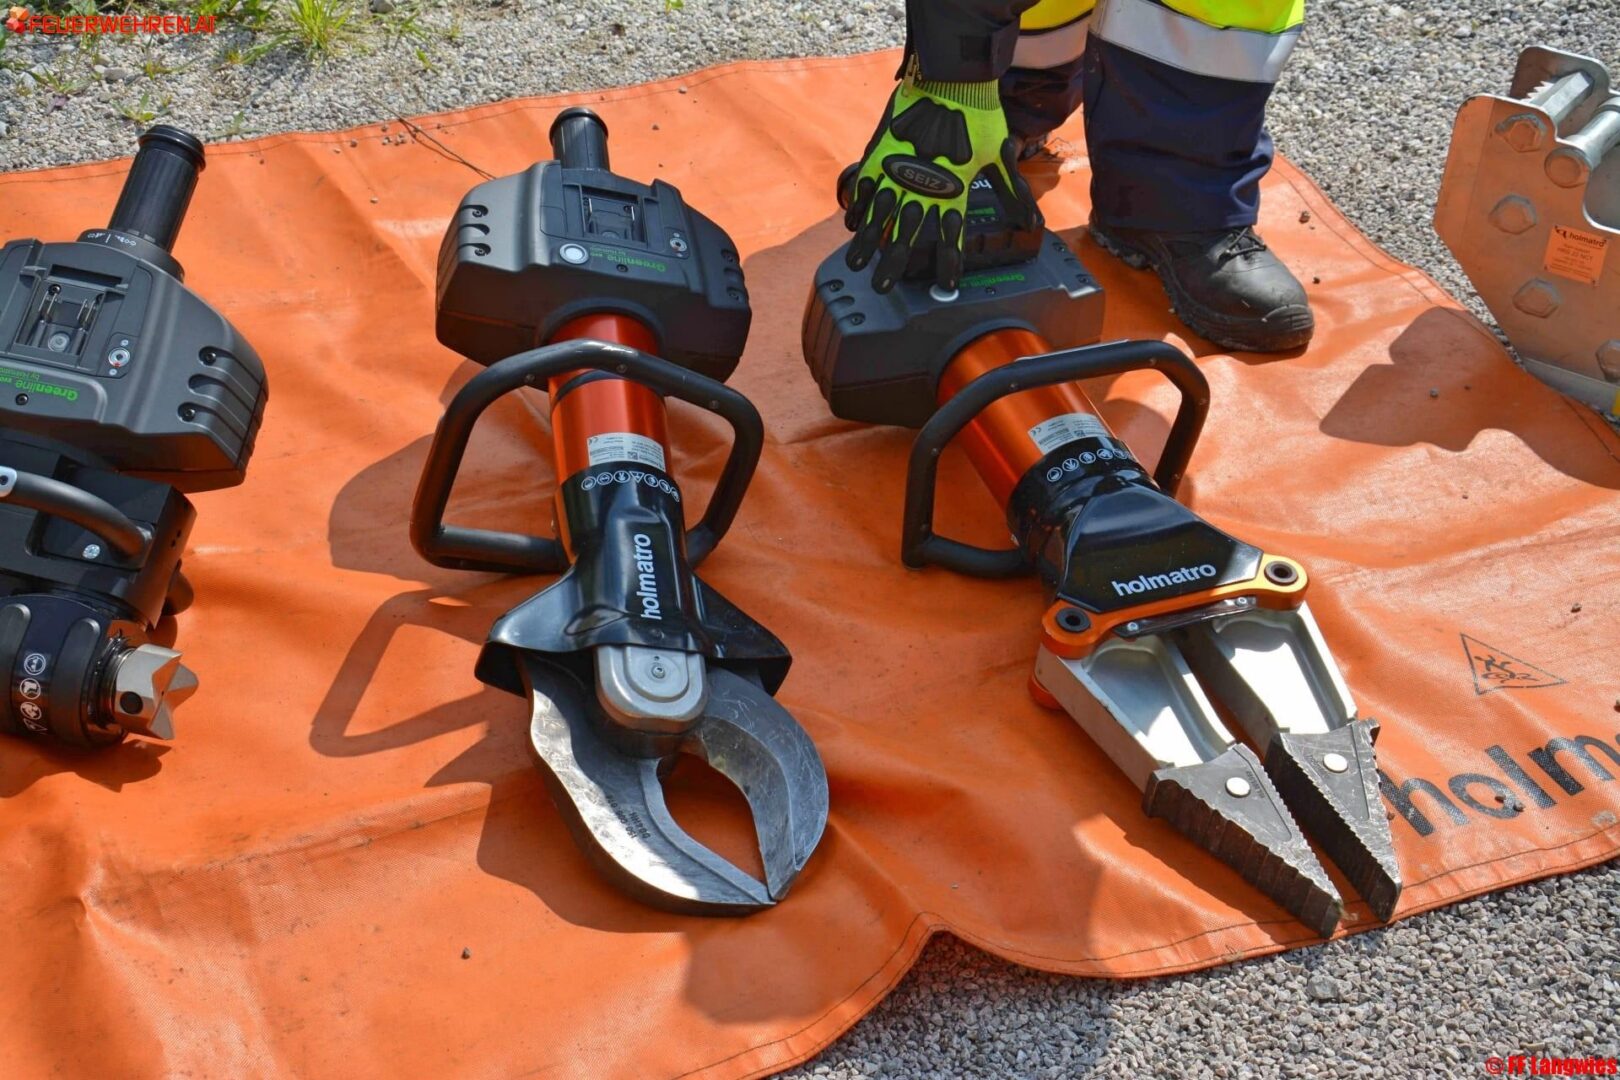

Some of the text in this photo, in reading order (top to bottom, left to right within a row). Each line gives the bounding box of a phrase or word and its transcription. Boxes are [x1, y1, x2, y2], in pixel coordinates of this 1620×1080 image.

[903, 168, 941, 191] SEIZ
[606, 254, 667, 273] Greenline
[15, 380, 79, 401] Greenline
[633, 533, 662, 621] holmatro
[1111, 562, 1217, 597] holmatro
[1377, 733, 1620, 837] holm
